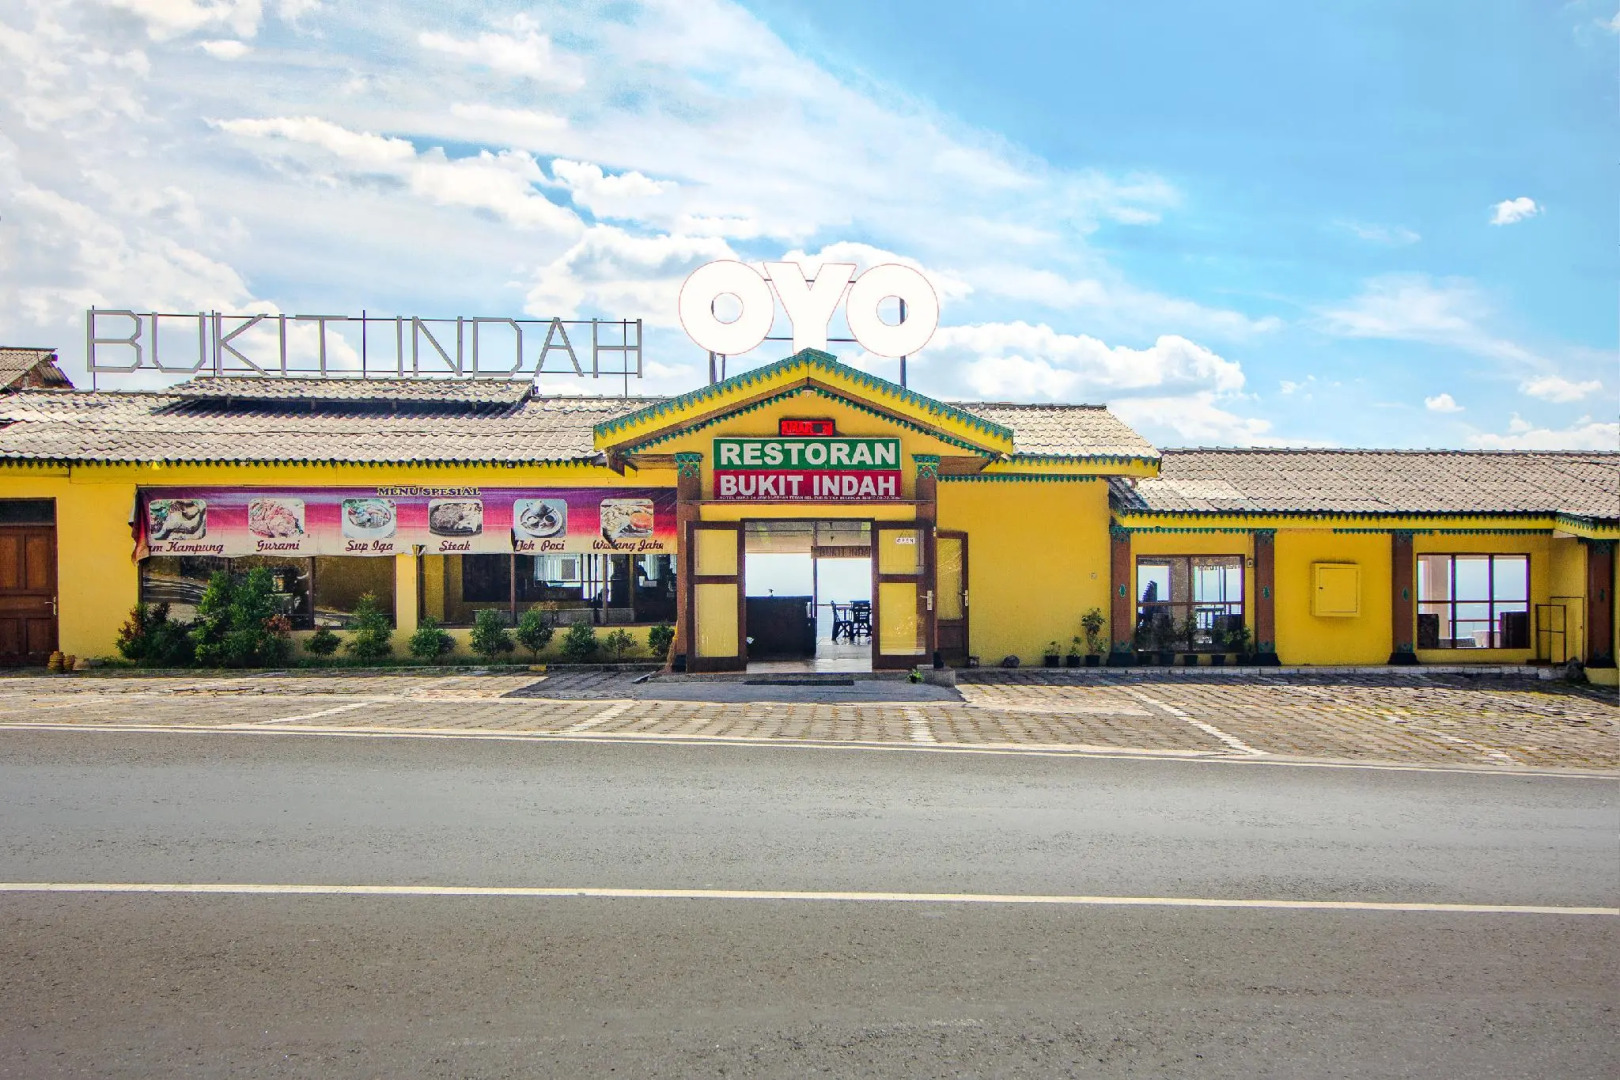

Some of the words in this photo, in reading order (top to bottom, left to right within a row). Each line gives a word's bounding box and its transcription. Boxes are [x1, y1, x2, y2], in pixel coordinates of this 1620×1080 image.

[679, 260, 939, 357] OYO
[87, 310, 347, 376] BUKIT
[397, 316, 642, 378] INDAH
[720, 442, 896, 466] RESTORAN
[378, 487, 418, 496] MENU
[423, 487, 480, 496] SPESIAL
[720, 475, 803, 496] BUKIT
[813, 475, 896, 496] INDAH
[166, 541, 224, 554] Kampung
[256, 540, 300, 552] Gurami
[345, 540, 369, 552] Sup
[371, 540, 394, 553] Iga
[439, 540, 471, 552] Steak
[541, 539, 566, 552] Poci
[637, 539, 664, 552] Jahe
